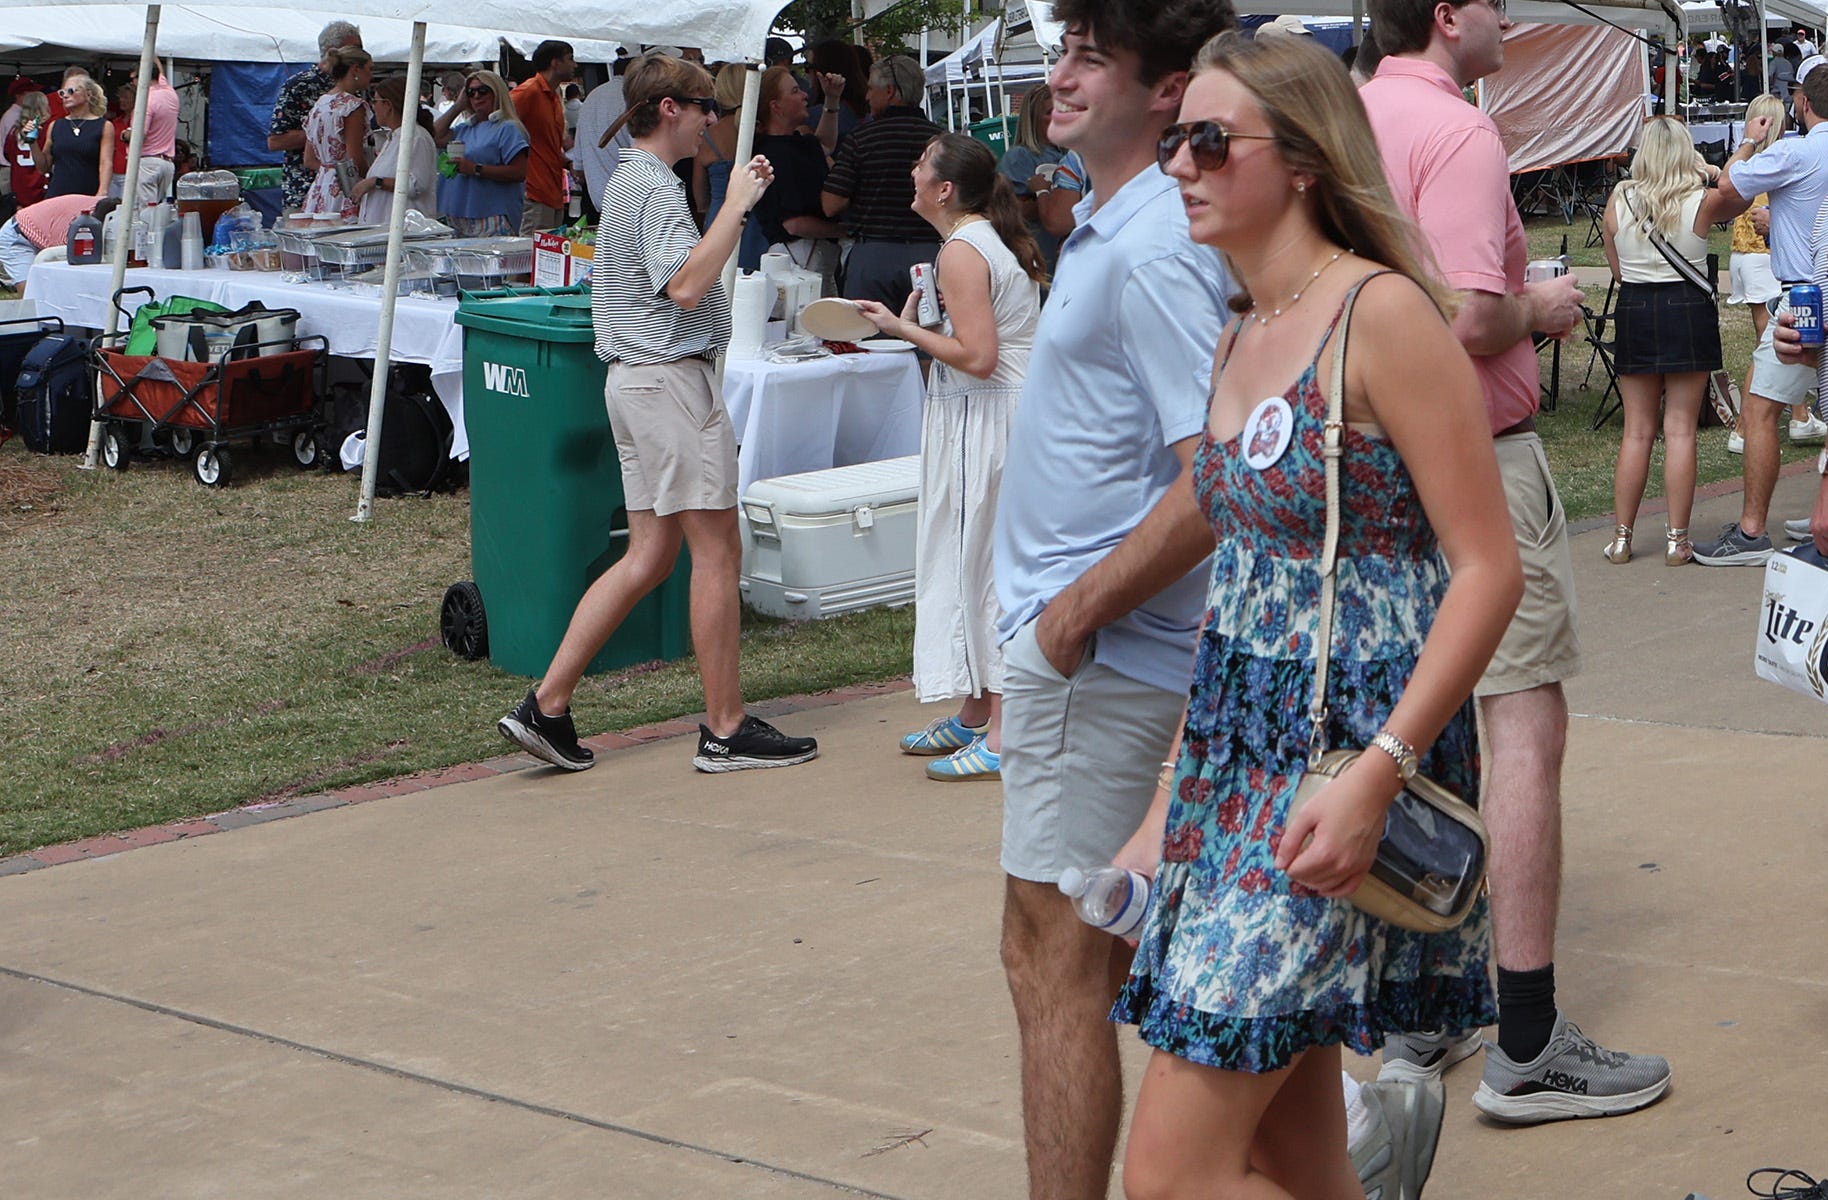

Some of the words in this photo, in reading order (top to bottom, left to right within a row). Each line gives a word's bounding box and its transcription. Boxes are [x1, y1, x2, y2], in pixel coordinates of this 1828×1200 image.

[483, 361, 529, 397] WM
[1765, 598, 1815, 646] Lite
[703, 740, 730, 755] HOKA
[1541, 1068, 1589, 1095] HOKA
